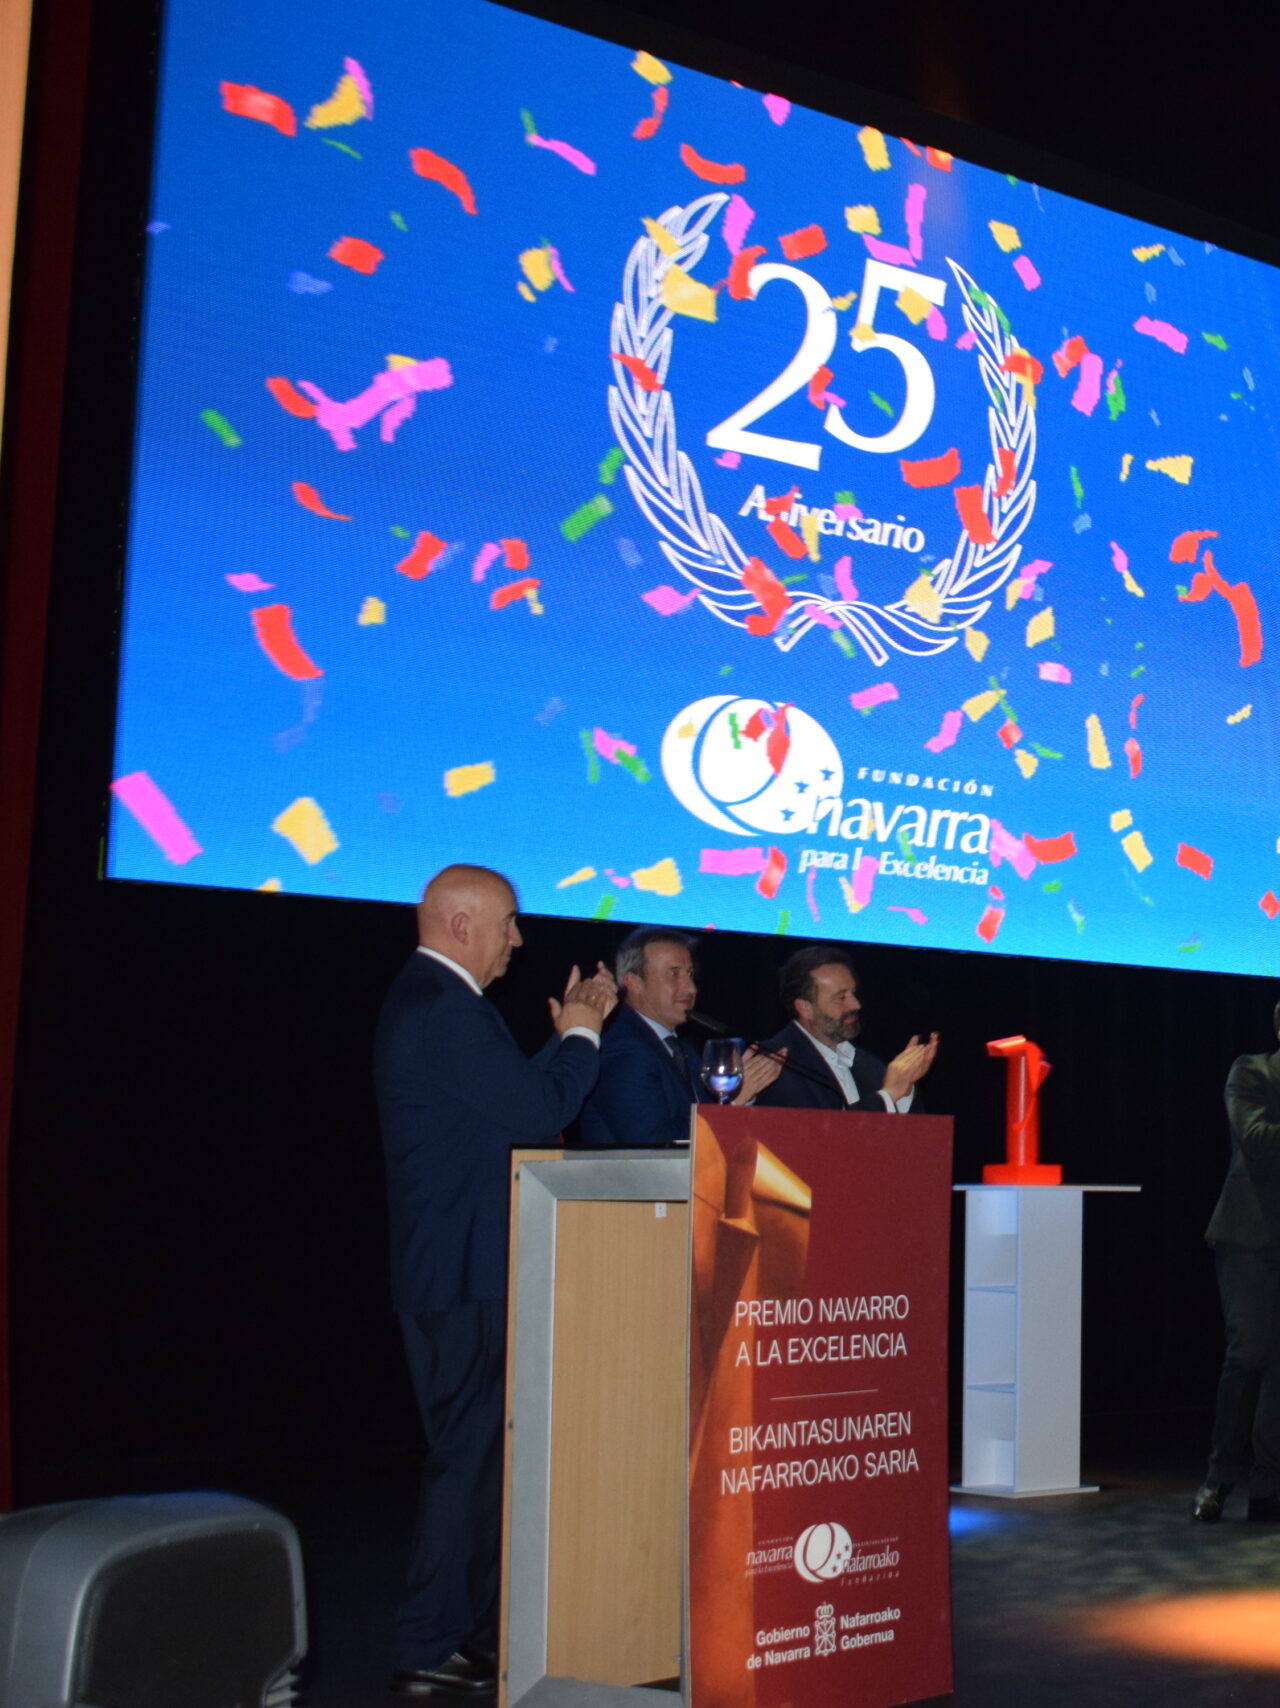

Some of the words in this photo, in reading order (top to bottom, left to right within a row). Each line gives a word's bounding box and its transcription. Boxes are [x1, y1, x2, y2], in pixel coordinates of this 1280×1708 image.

[706, 257, 947, 471] 25
[857, 766, 995, 798] FUNDACIÓN
[805, 795, 991, 854] navarra
[797, 848, 849, 874] para
[878, 850, 989, 886] Excelencia
[734, 1298, 814, 1328] PREMIO
[818, 1294, 910, 1324] NAVARRO
[735, 1340, 751, 1368] A
[756, 1339, 783, 1367] LA
[787, 1332, 908, 1365] EXCELENCIA
[729, 1411, 913, 1455] BIKAINTASUNAREN
[720, 1454, 860, 1496] NAFARROAKO
[864, 1447, 920, 1479] SARIA
[745, 1545, 794, 1566] navarra
[842, 1545, 900, 1574] nafarroako
[840, 1607, 901, 1630] Nafarroako
[756, 1624, 811, 1647] Gobierno
[840, 1628, 895, 1650] Gobernua
[746, 1654, 762, 1670] de
[764, 1646, 811, 1667] Navarra
